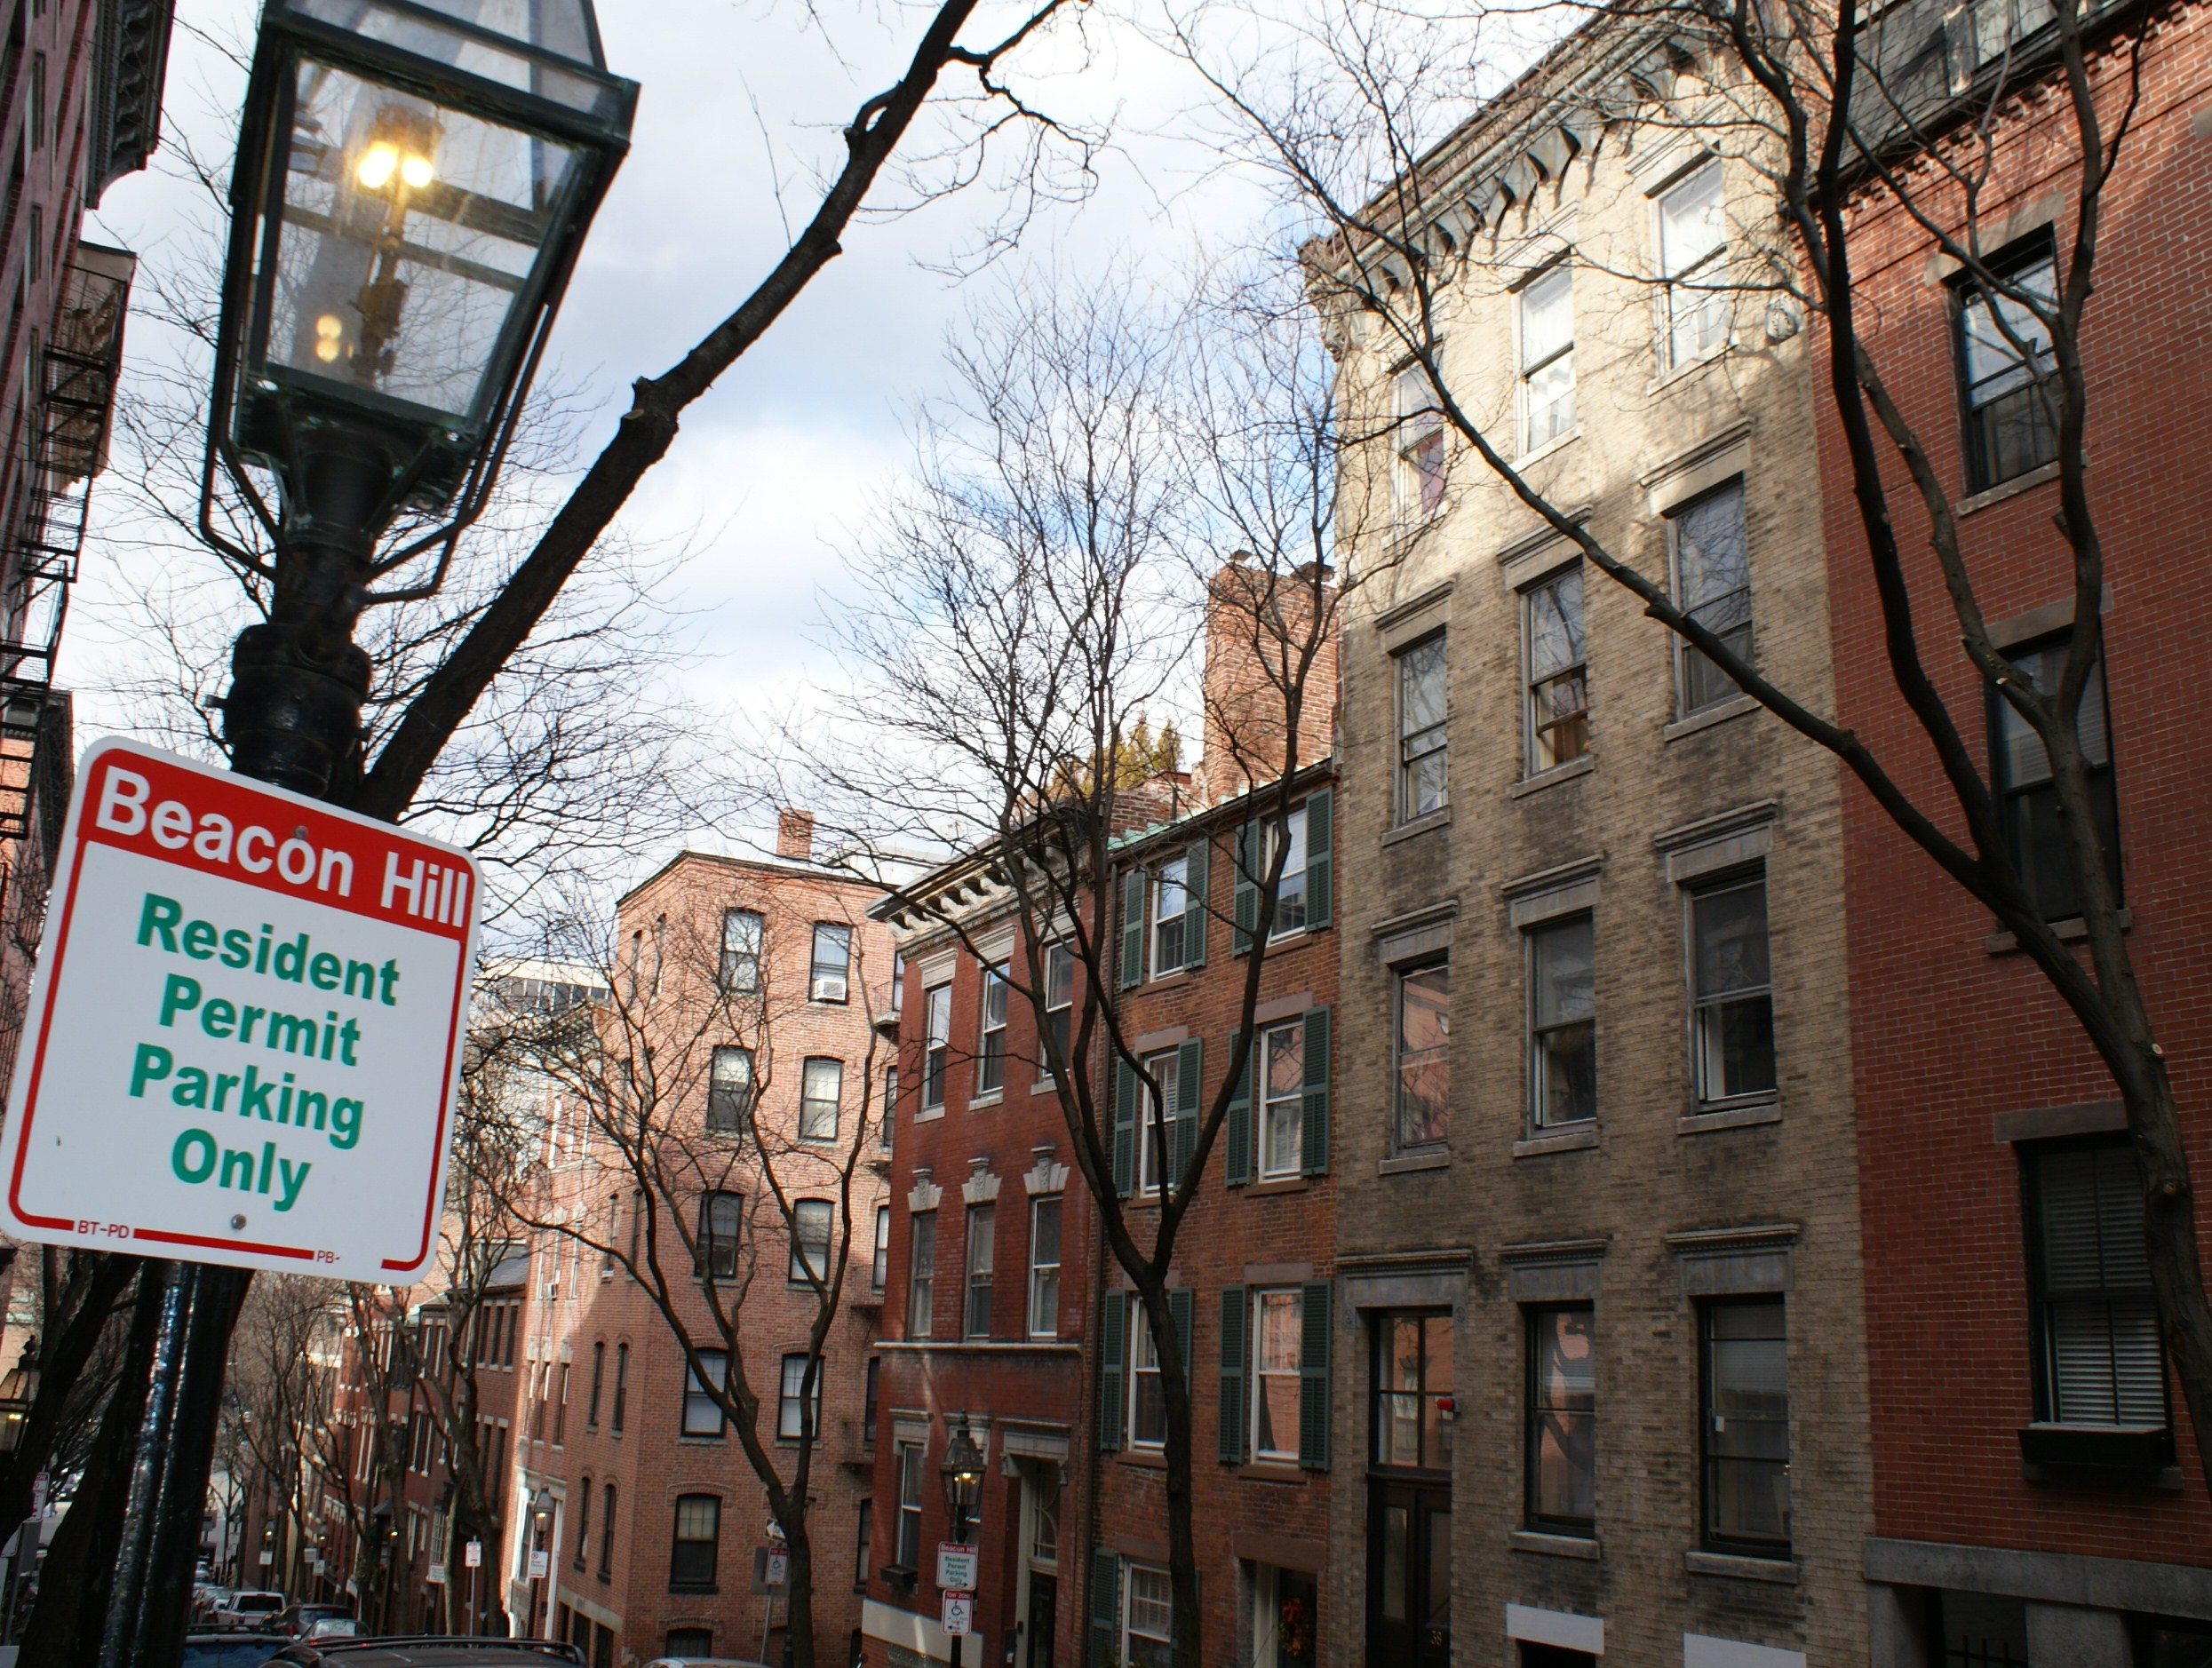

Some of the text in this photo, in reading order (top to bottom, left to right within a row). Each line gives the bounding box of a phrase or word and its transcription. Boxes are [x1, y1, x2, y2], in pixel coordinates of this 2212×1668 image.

[96, 766, 469, 928] Beacon Hill
[137, 893, 400, 1006] Resident
[158, 973, 362, 1067] Permit
[129, 1042, 365, 1150] Parking
[171, 1128, 312, 1212] Only
[77, 1219, 131, 1239] BT-PD
